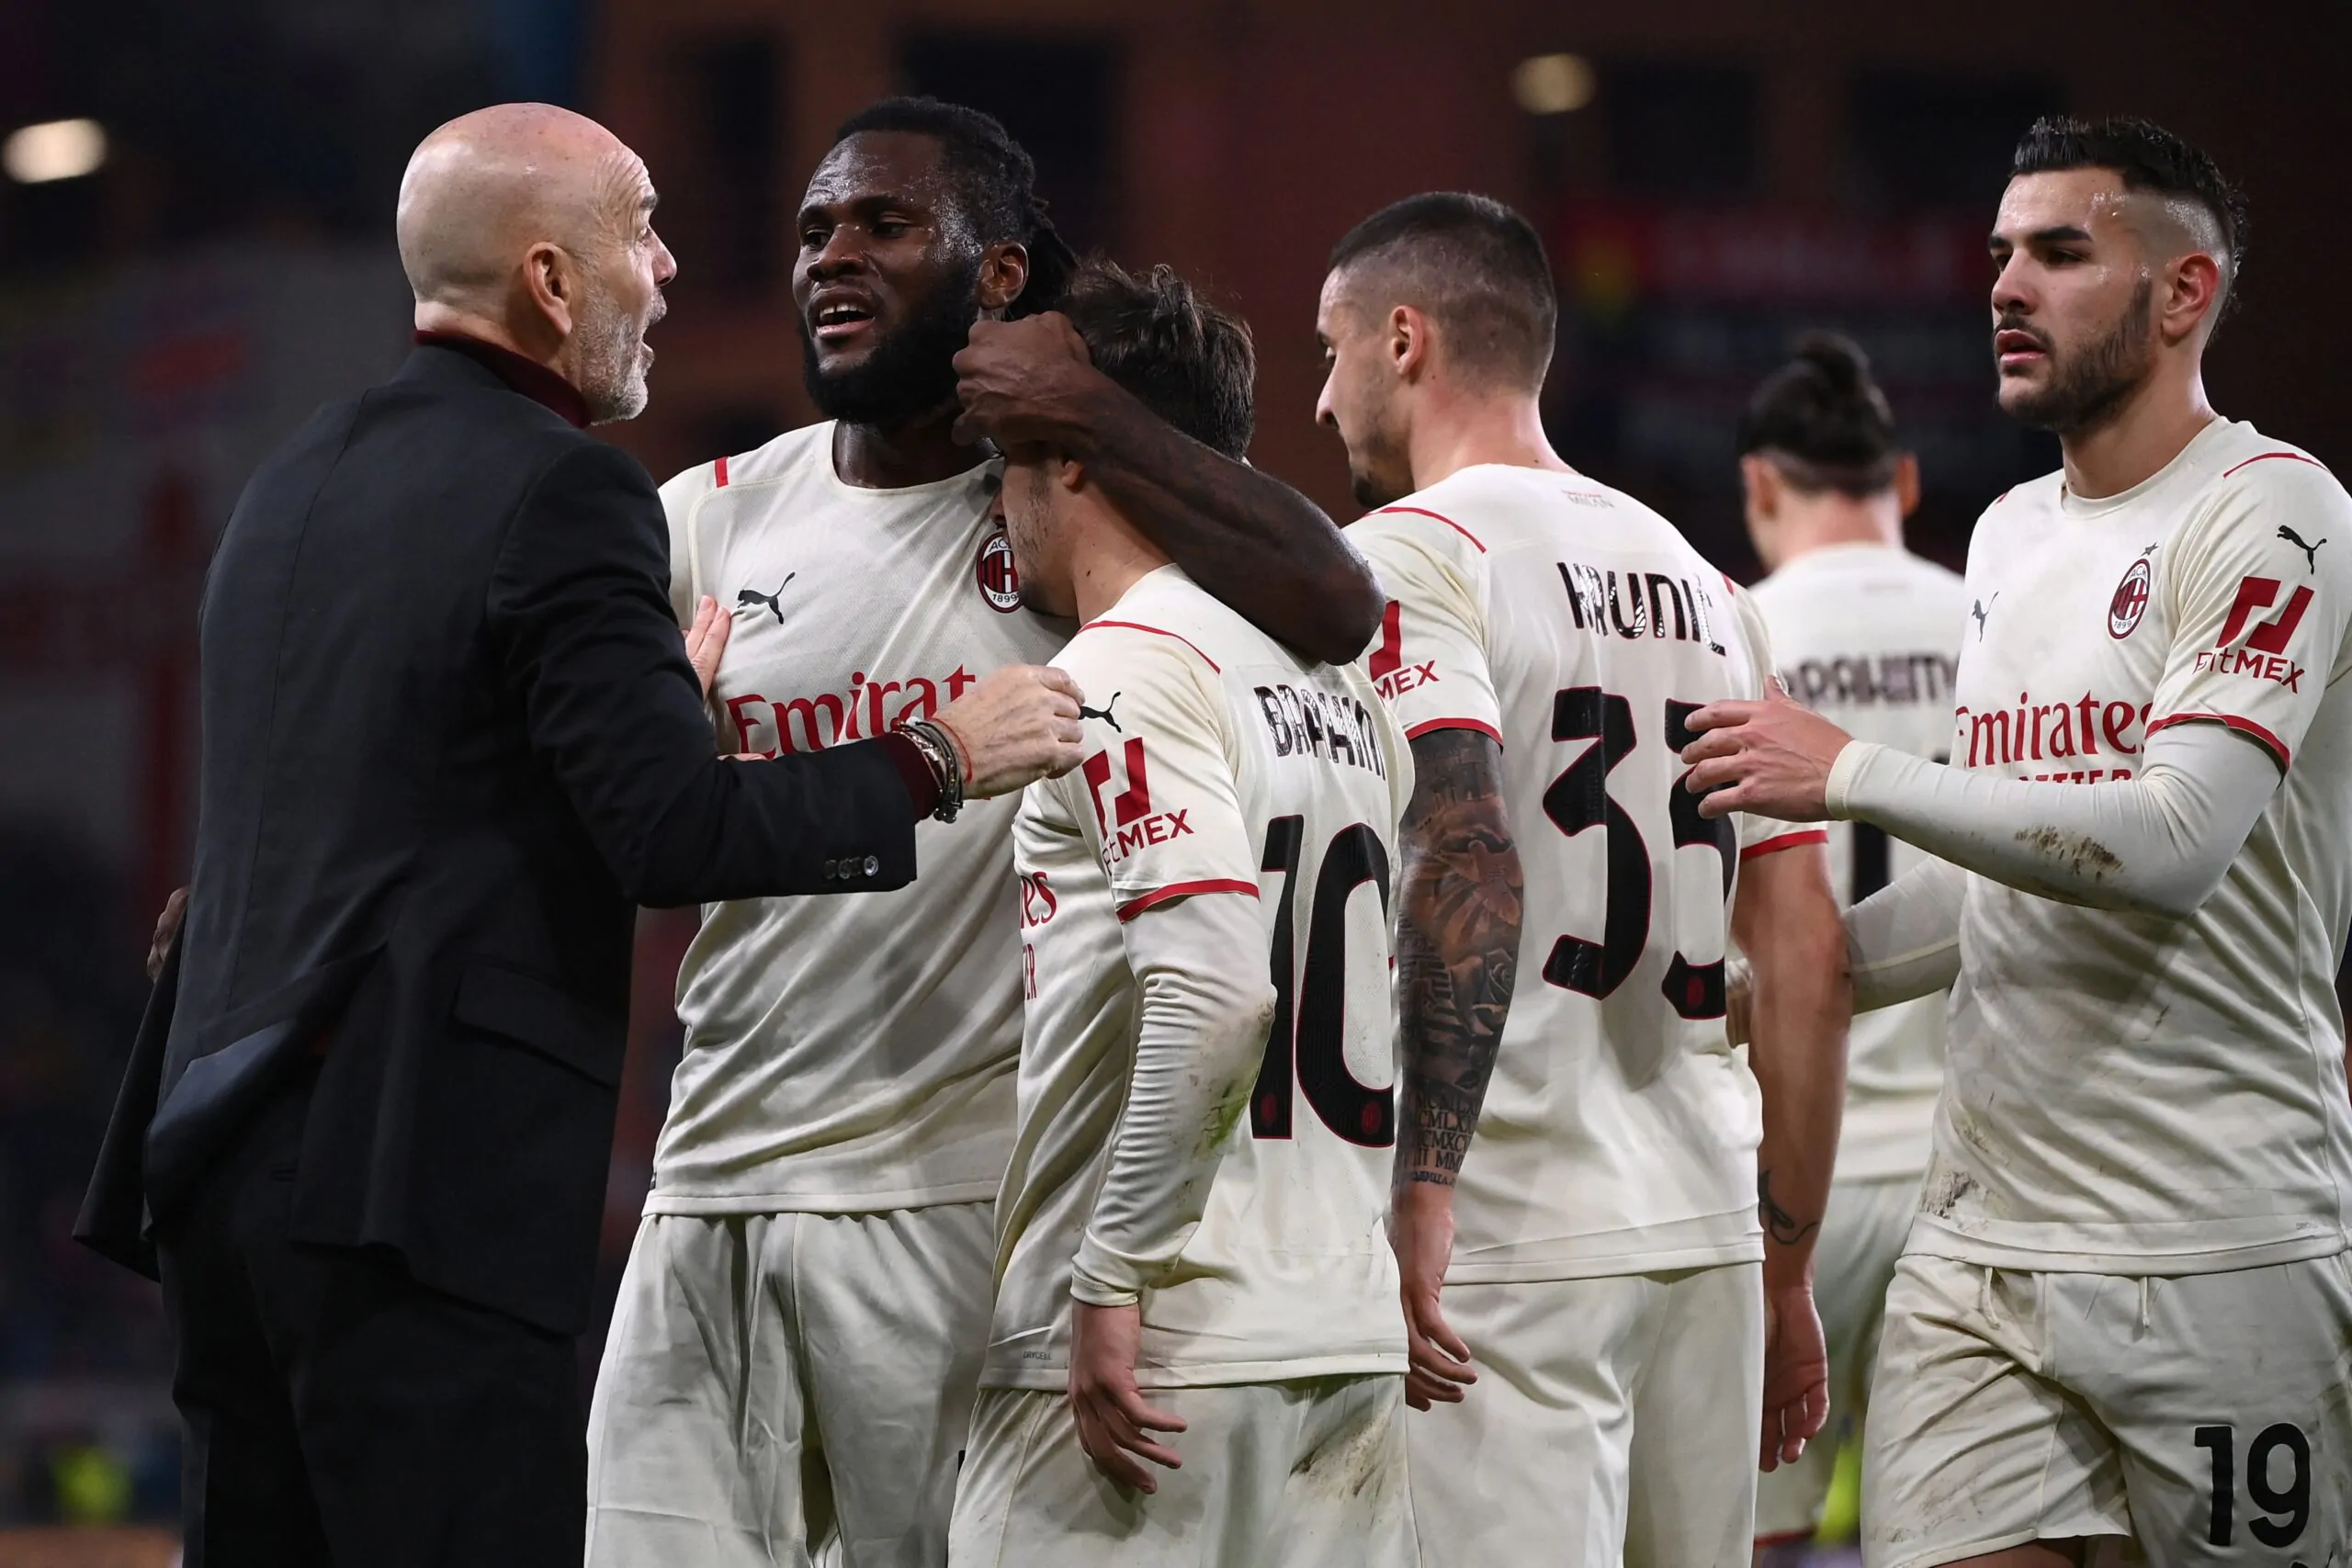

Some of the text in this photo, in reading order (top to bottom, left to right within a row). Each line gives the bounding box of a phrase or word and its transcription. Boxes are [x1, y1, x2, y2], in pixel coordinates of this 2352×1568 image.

[989, 538, 1012, 552] AC
[993, 593, 1017, 603] 1899
[2114, 621, 2132, 629] 1899
[727, 663, 976, 759] Emirat
[1374, 660, 1440, 701] MEX
[1543, 686, 1737, 1021] 35
[1250, 814, 1395, 1148] 10
[2194, 1422, 2311, 1549] 19
